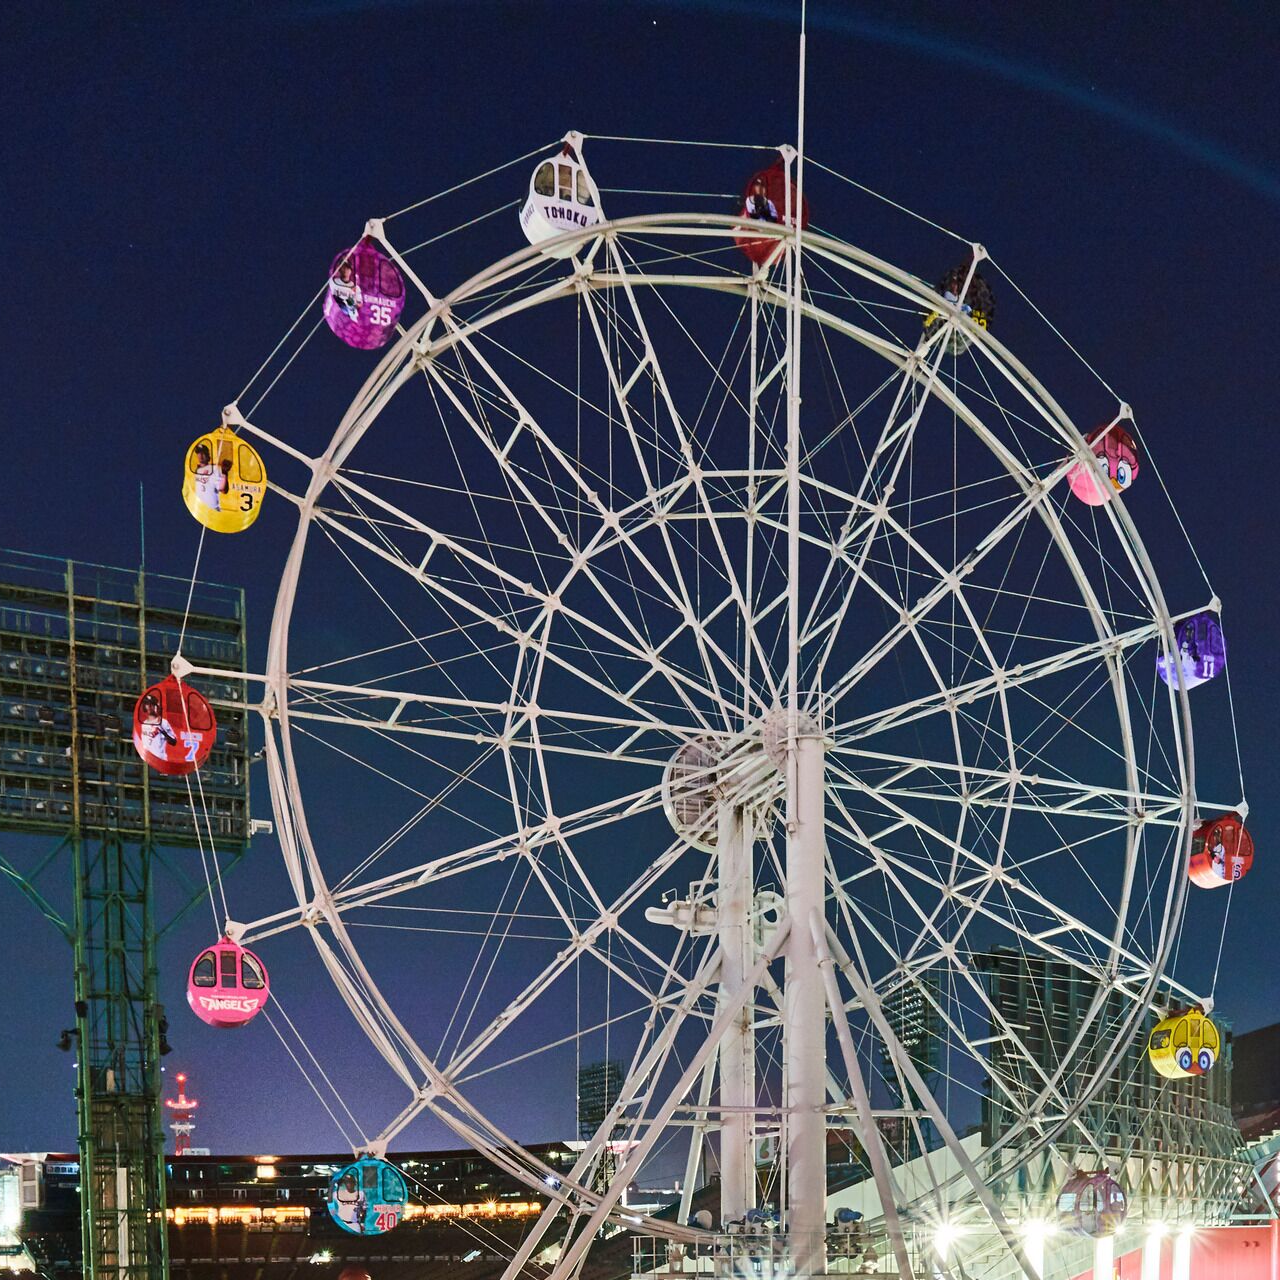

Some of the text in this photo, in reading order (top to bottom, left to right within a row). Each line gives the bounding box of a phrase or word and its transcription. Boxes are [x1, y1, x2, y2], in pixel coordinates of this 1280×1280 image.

[544, 206, 587, 227] TOHOKU
[370, 304, 391, 326] 35
[240, 493, 253, 511] 3
[1202, 661, 1214, 678] 11
[184, 740, 199, 761] 7
[208, 999, 252, 1013] ANGELS
[375, 1212, 398, 1231] 40
